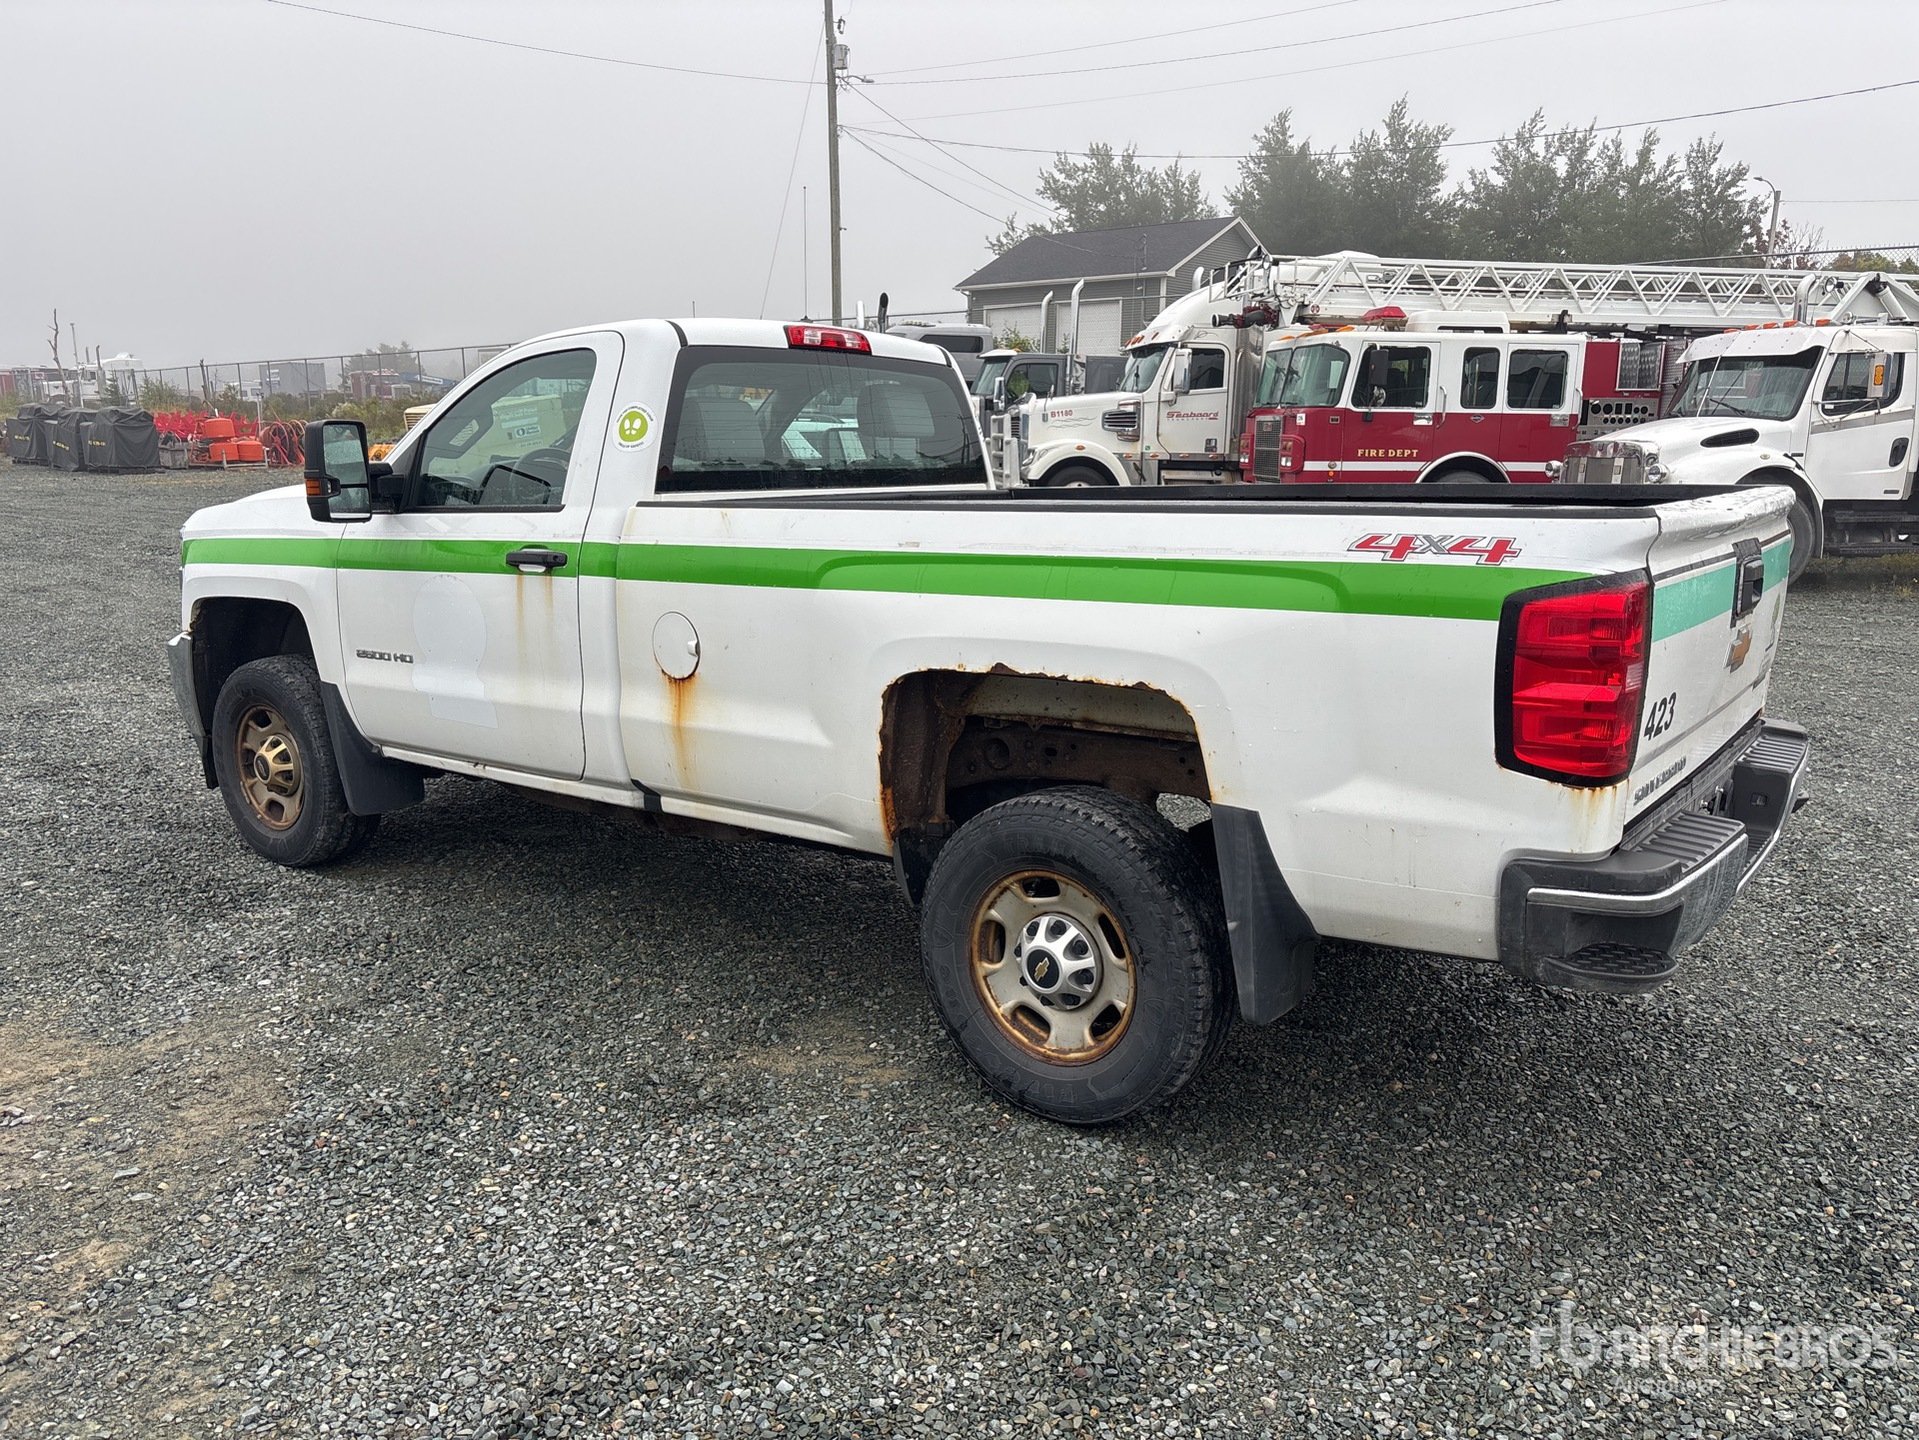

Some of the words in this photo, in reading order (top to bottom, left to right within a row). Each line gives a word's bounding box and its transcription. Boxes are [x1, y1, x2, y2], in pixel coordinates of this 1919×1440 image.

[1050, 409, 1073, 418] B1180
[1166, 411, 1219, 419] Seaboard
[1357, 448, 1386, 458] FIRE
[1388, 448, 1418, 458] DEPT
[356, 649, 391, 661] 2500
[393, 653, 413, 664] HD
[1643, 691, 1677, 742] 423
